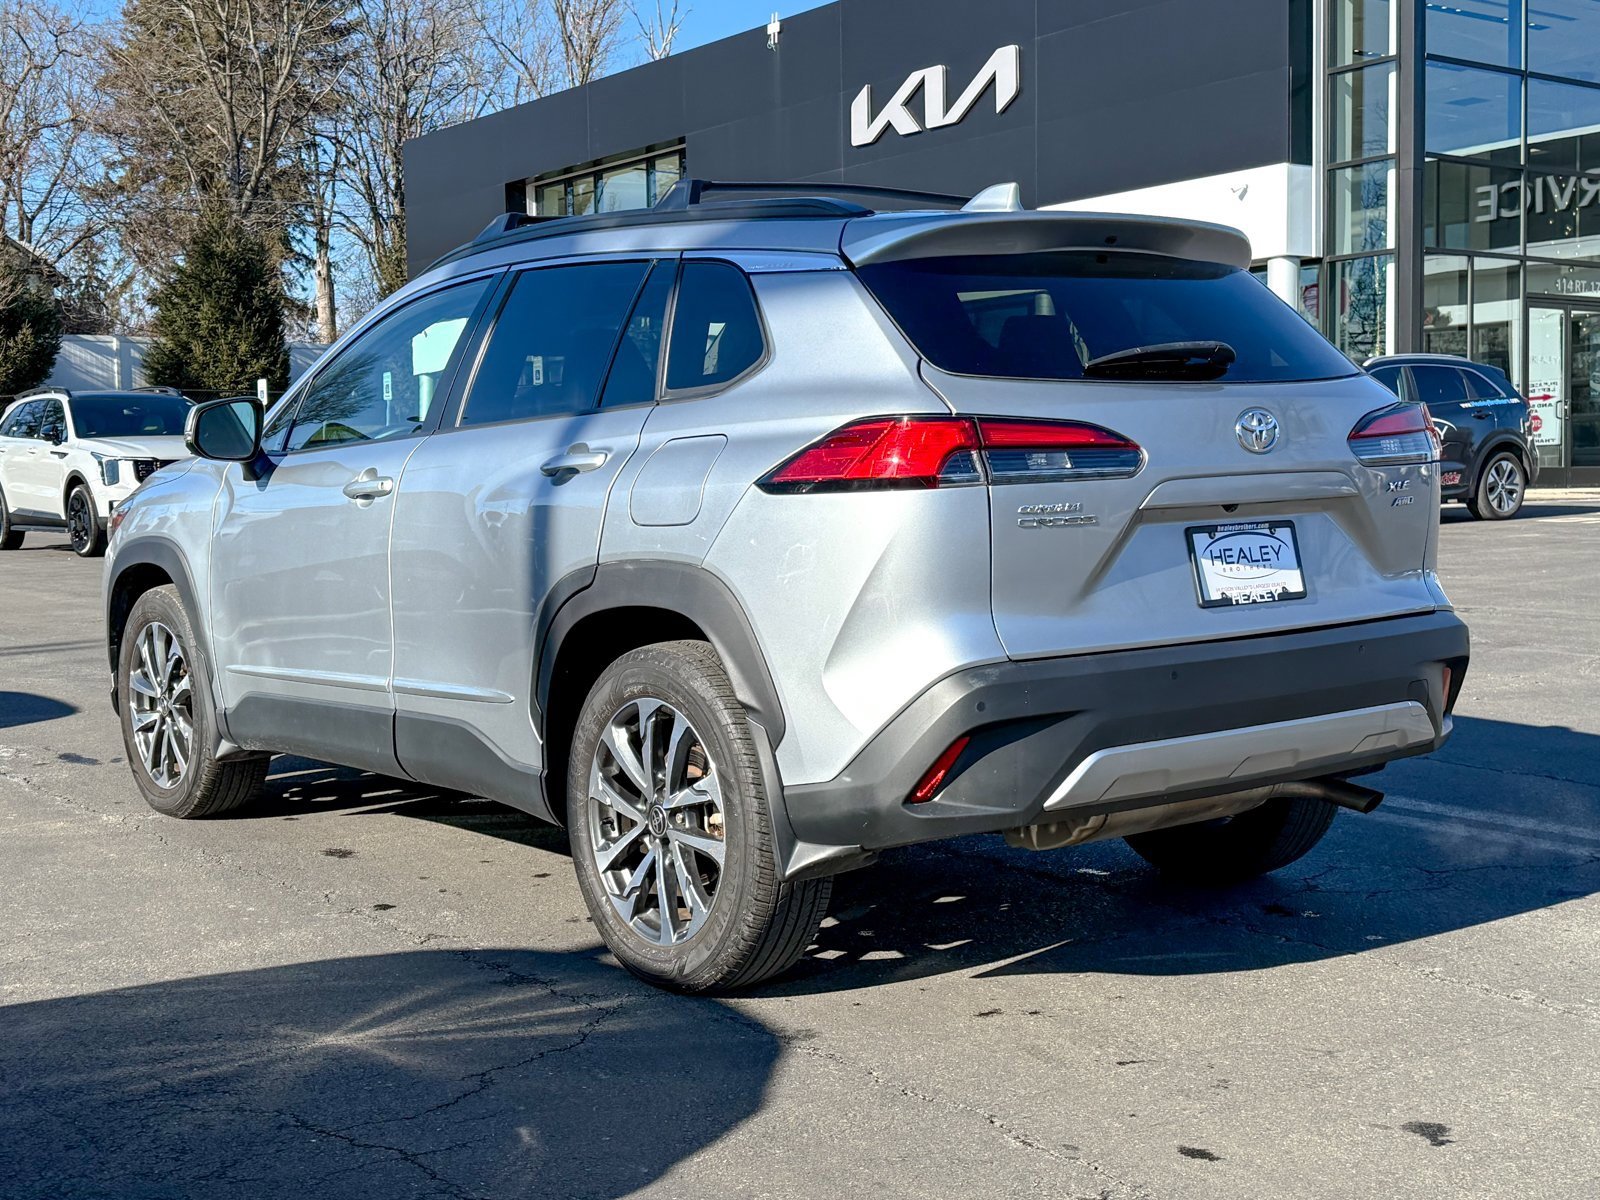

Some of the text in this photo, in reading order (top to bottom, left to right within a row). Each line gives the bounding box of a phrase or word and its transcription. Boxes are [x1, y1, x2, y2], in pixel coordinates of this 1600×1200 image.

[851, 45, 1019, 147] KIA
[1386, 480, 1410, 492] XLE
[1017, 515, 1097, 527] CROSS
[1209, 544, 1282, 567] HEALEY
[1231, 589, 1280, 605] HEALEY
